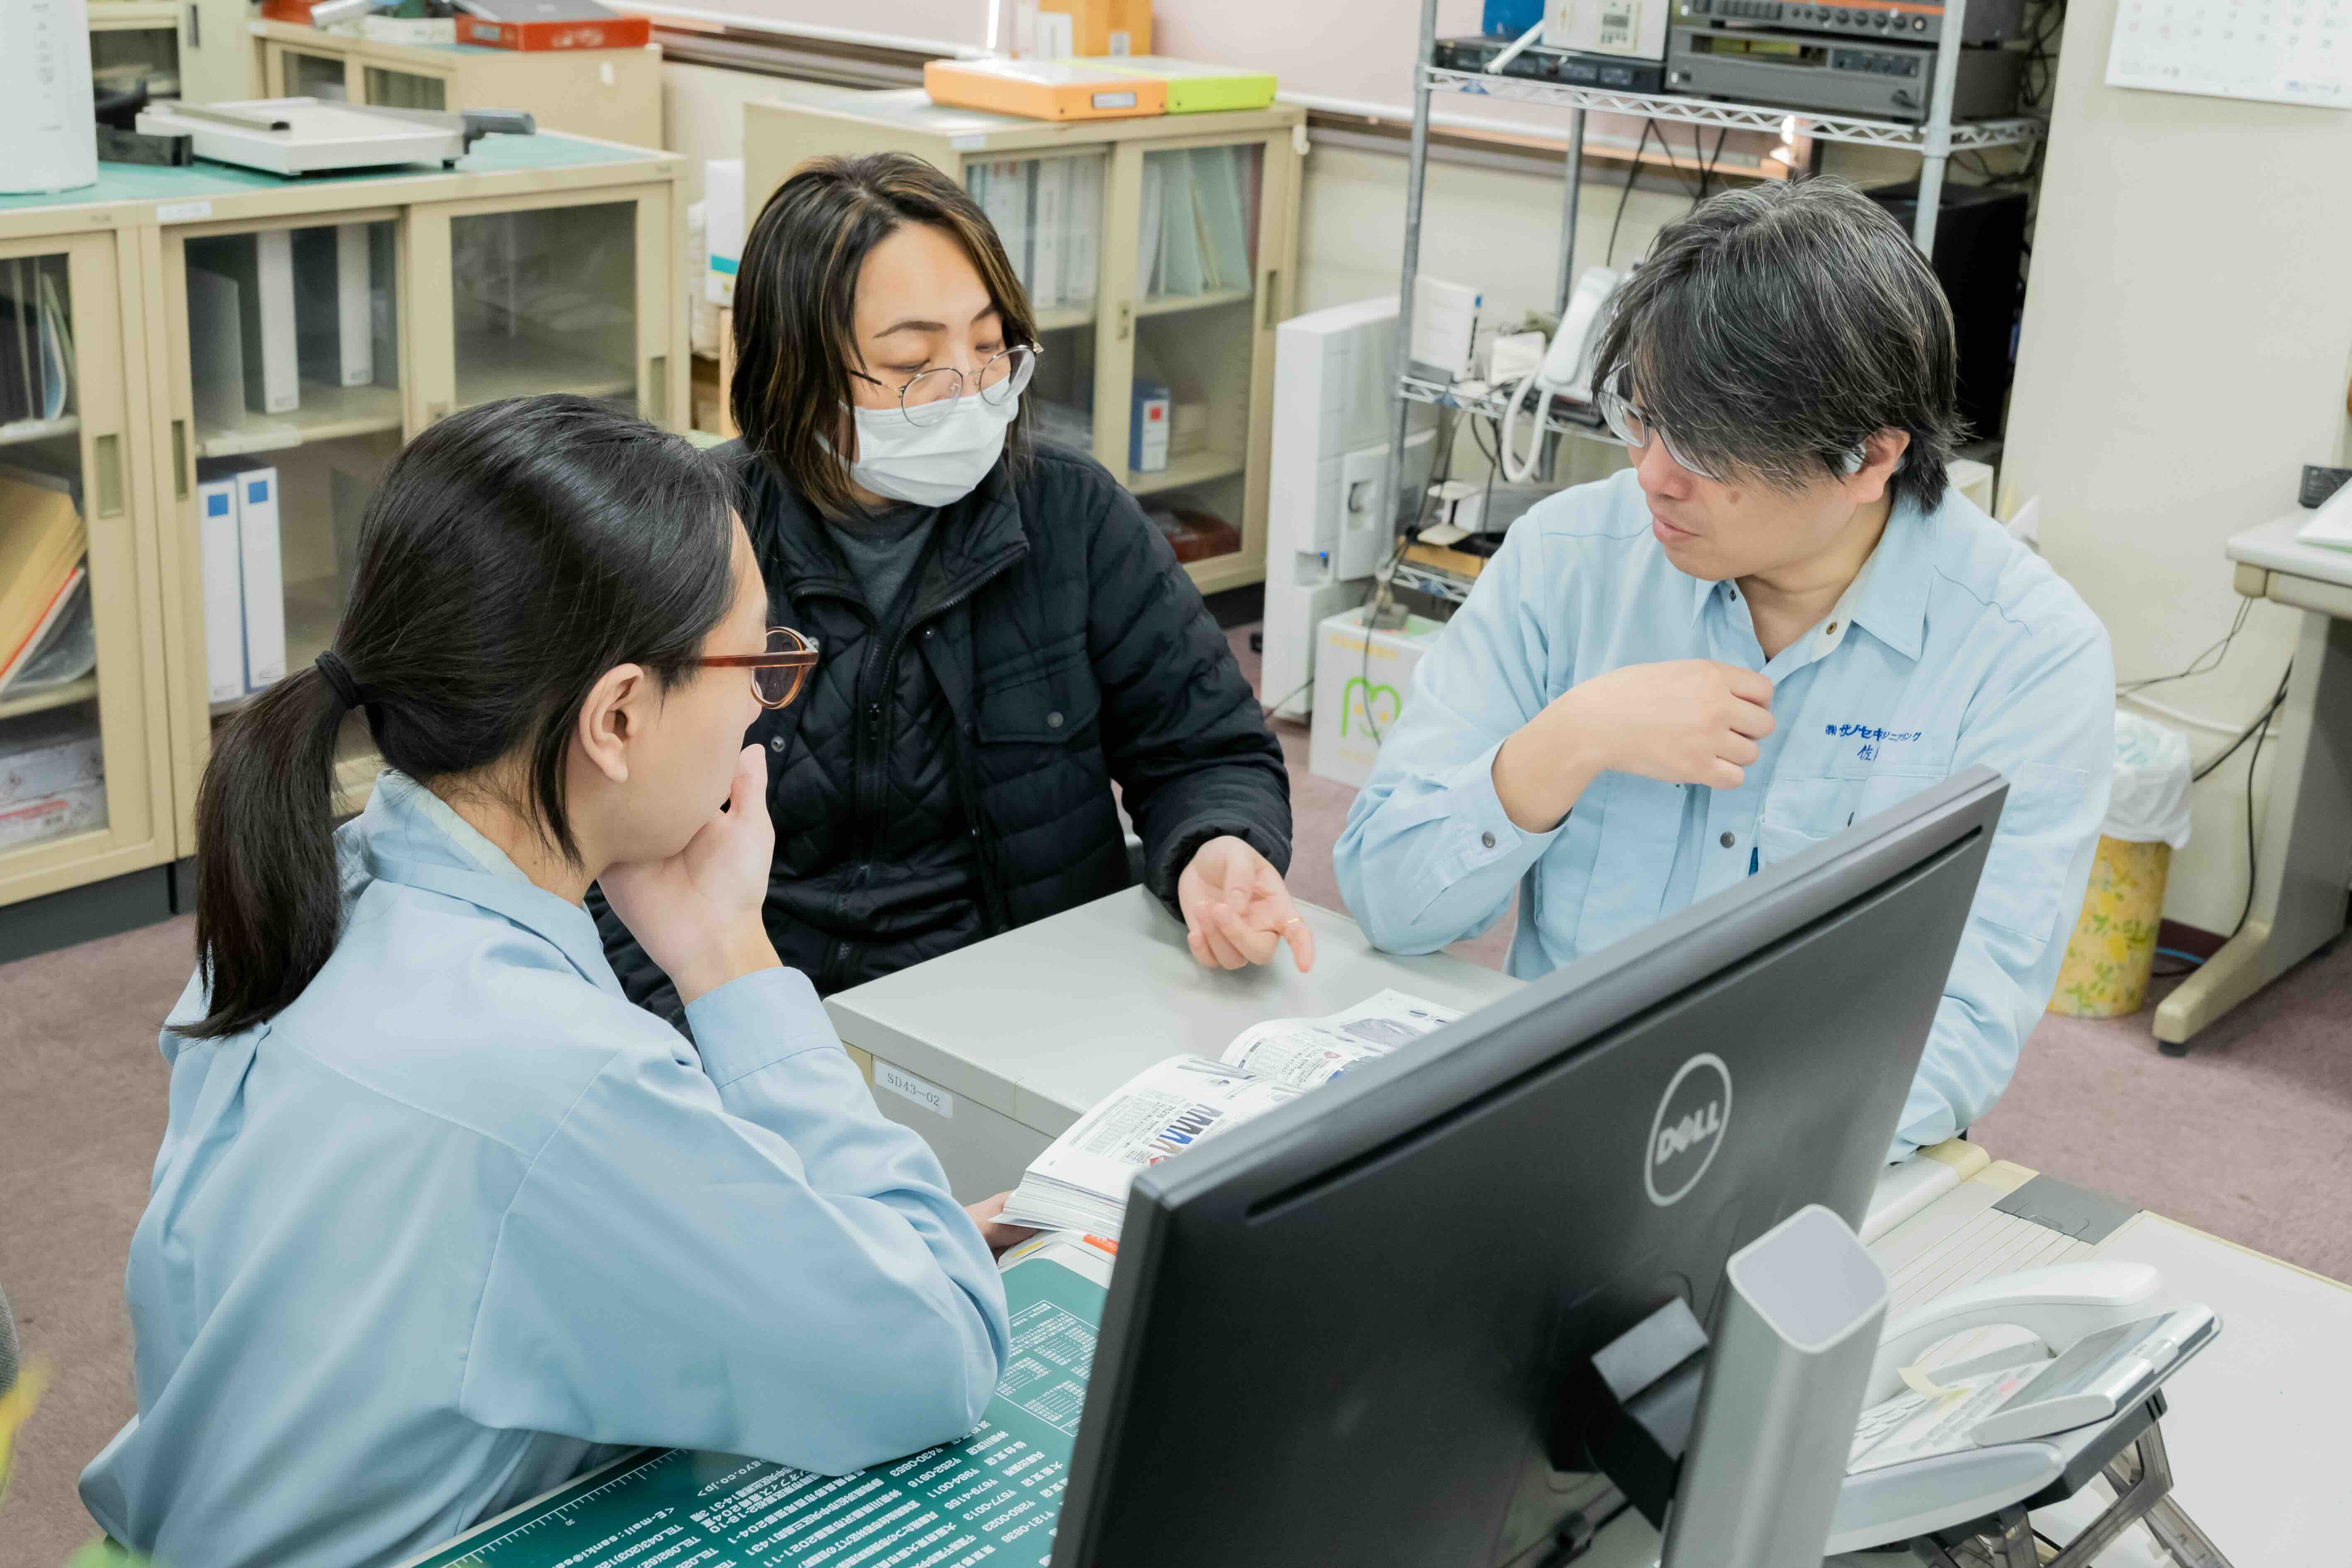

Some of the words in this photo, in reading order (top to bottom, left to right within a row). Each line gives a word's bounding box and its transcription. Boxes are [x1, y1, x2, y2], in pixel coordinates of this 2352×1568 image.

[887, 1072, 940, 1107] SD43-02
[1655, 1098, 1721, 1166] DELL
[966, 1431, 1009, 1455] 神奈川支店
[984, 1441, 1026, 1466] 仙台支店
[890, 1449, 943, 1477] 〒430-0853
[907, 1458, 962, 1487] 〒252-0816
[1021, 1461, 1063, 1487] 大阪支店
[927, 1468, 980, 1498] 〒984-0011
[944, 1479, 998, 1509] 〒679-4155
[963, 1490, 1016, 1520] 〒577-0013
[870, 1522, 956, 1568] 大阪府東大阪市長
